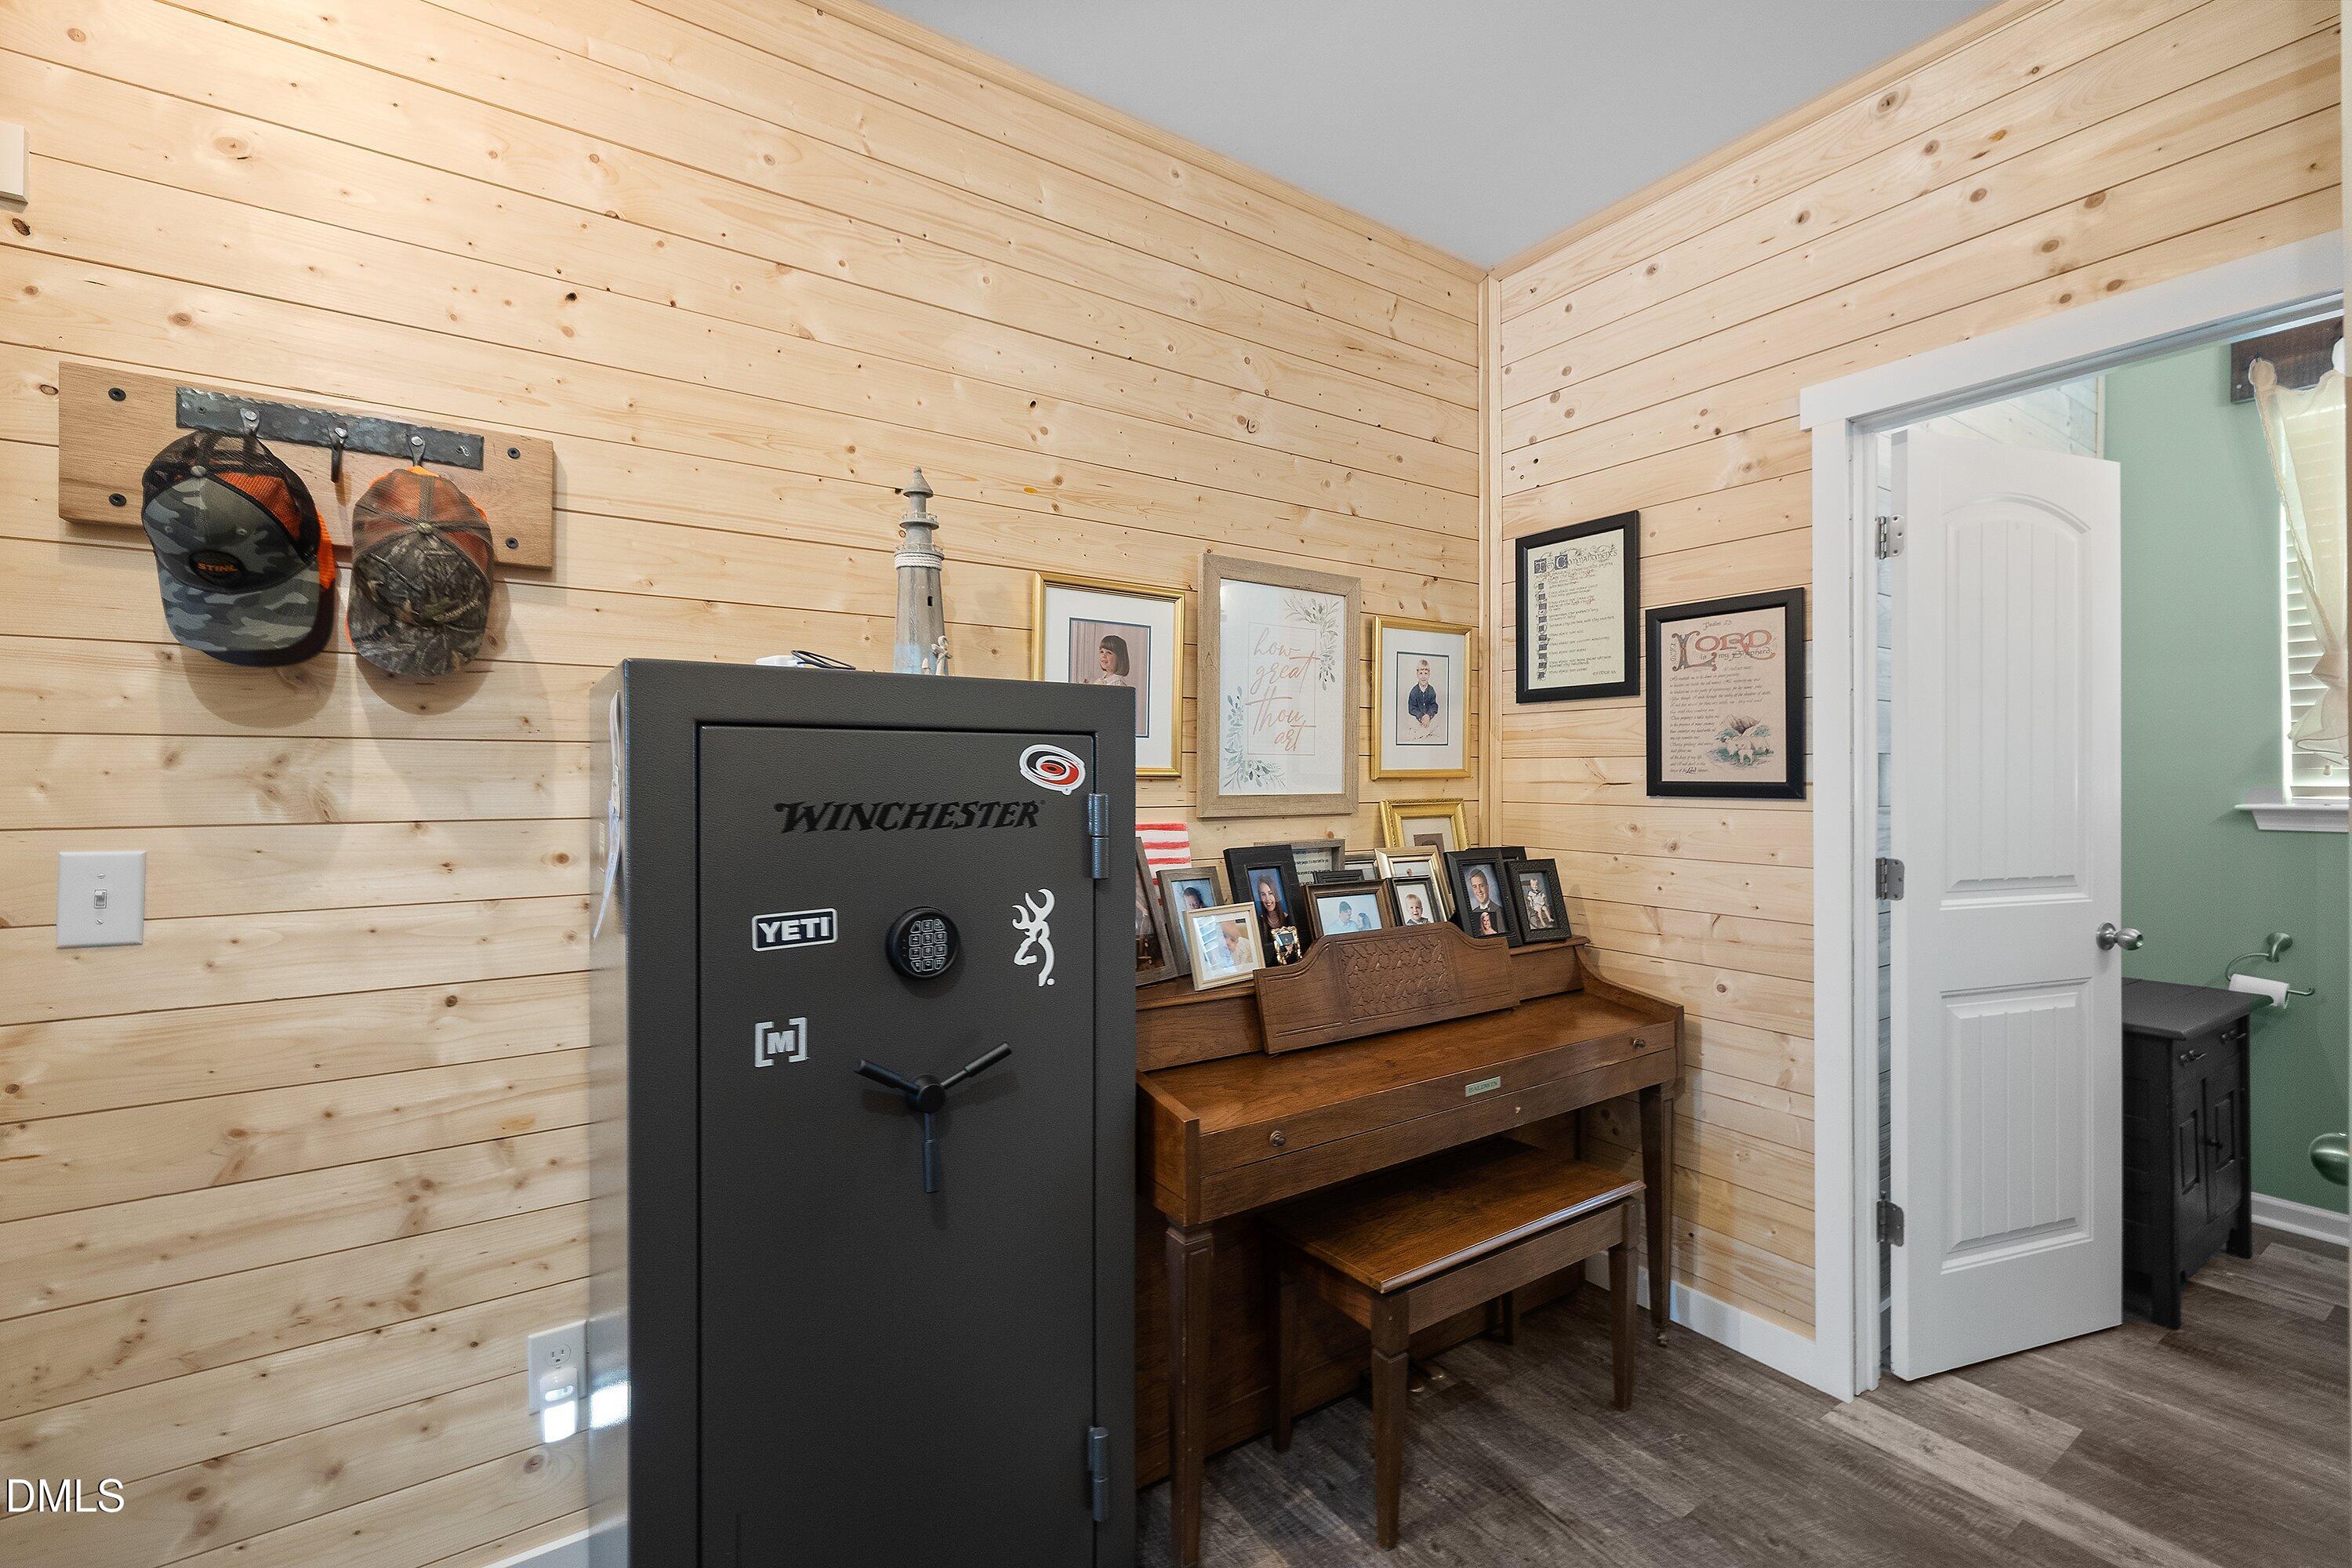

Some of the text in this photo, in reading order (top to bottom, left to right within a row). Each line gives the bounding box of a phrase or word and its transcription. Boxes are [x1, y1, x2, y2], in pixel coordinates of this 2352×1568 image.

[1254, 627, 1301, 655] how
[1250, 651, 1321, 695] great
[1245, 686, 1304, 735] thou
[1274, 720, 1316, 752] art
[773, 800, 1040, 833] WINCHESTER
[757, 916, 832, 943] YETI
